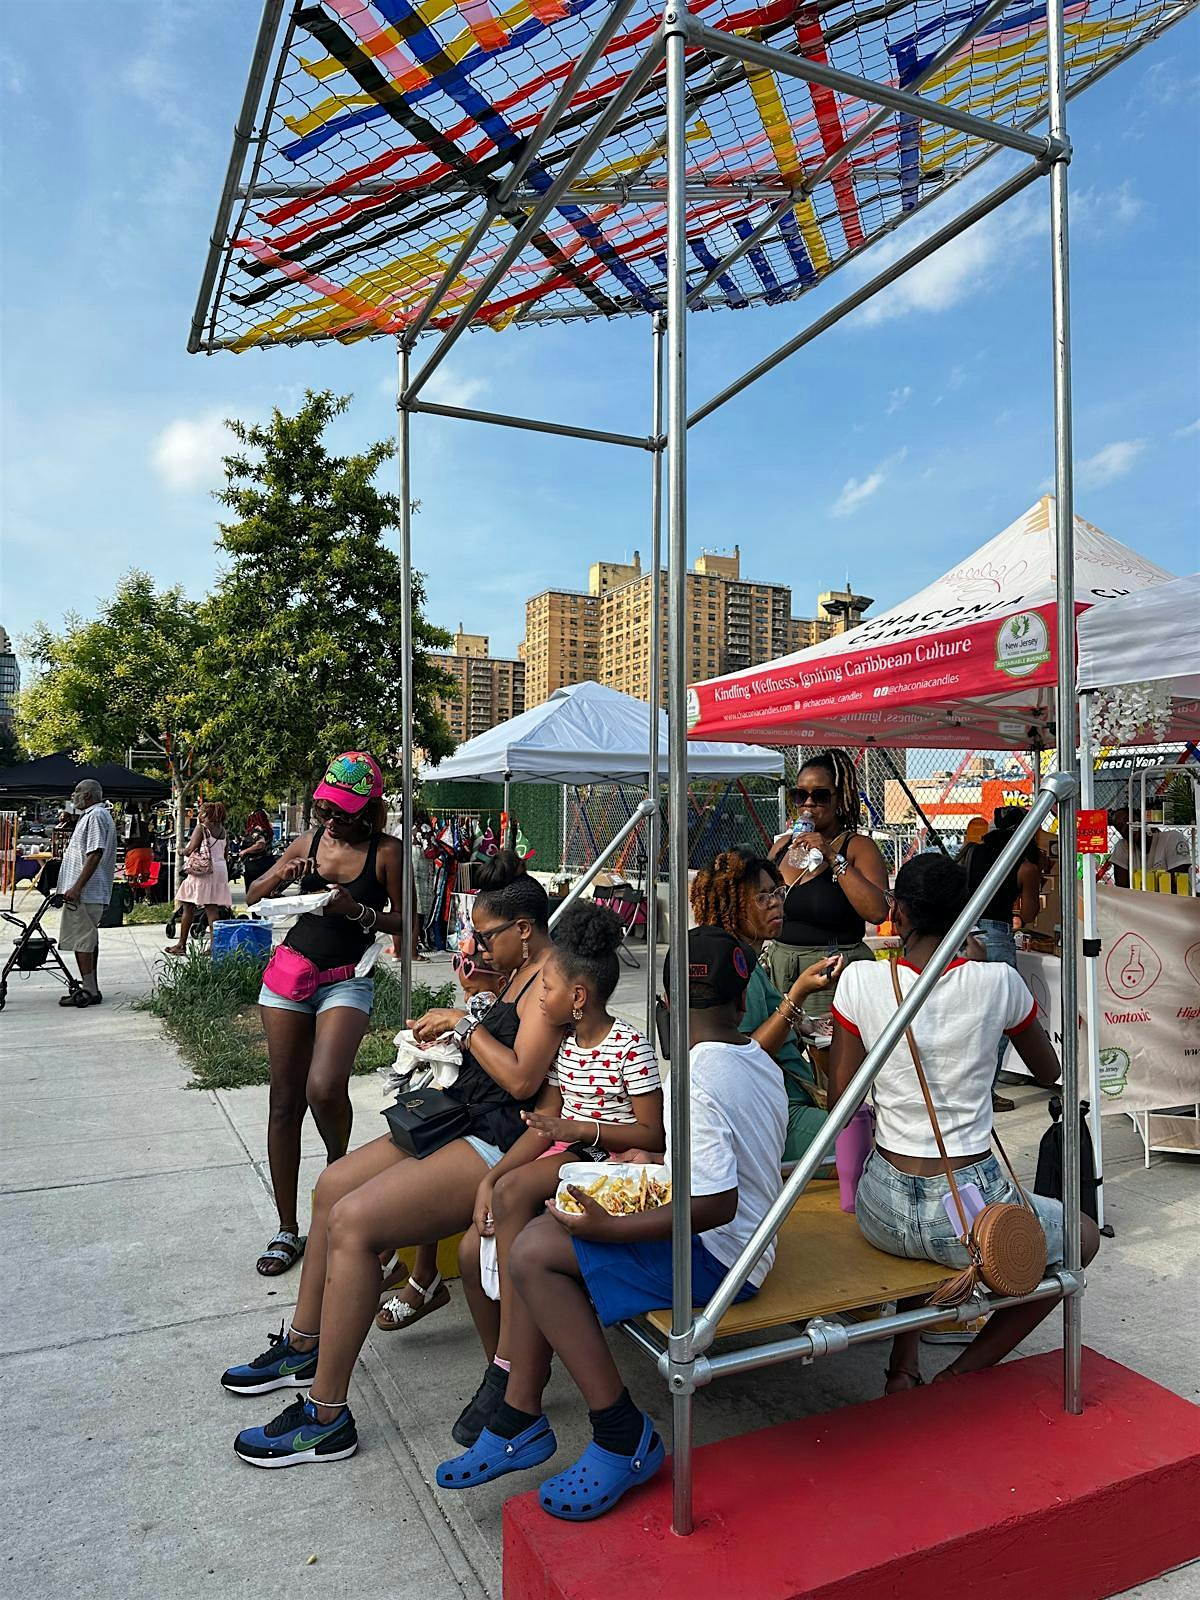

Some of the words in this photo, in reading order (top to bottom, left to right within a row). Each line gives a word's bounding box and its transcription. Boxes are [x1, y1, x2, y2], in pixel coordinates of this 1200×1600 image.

[864, 595, 1025, 631] CHACONIA
[1005, 642, 1019, 650] New
[1020, 638, 1039, 648] Jersey
[714, 684, 751, 702] Kindling
[752, 677, 799, 694] Wellness,
[799, 665, 843, 688] Igniting
[845, 654, 912, 677] Caribbean
[915, 638, 972, 662] Culture
[802, 690, 864, 710] @chaconia_candles
[887, 673, 960, 696] @chaconiacandles
[1135, 756, 1164, 768] Van?
[1104, 1008, 1151, 1025] Nontoxic
